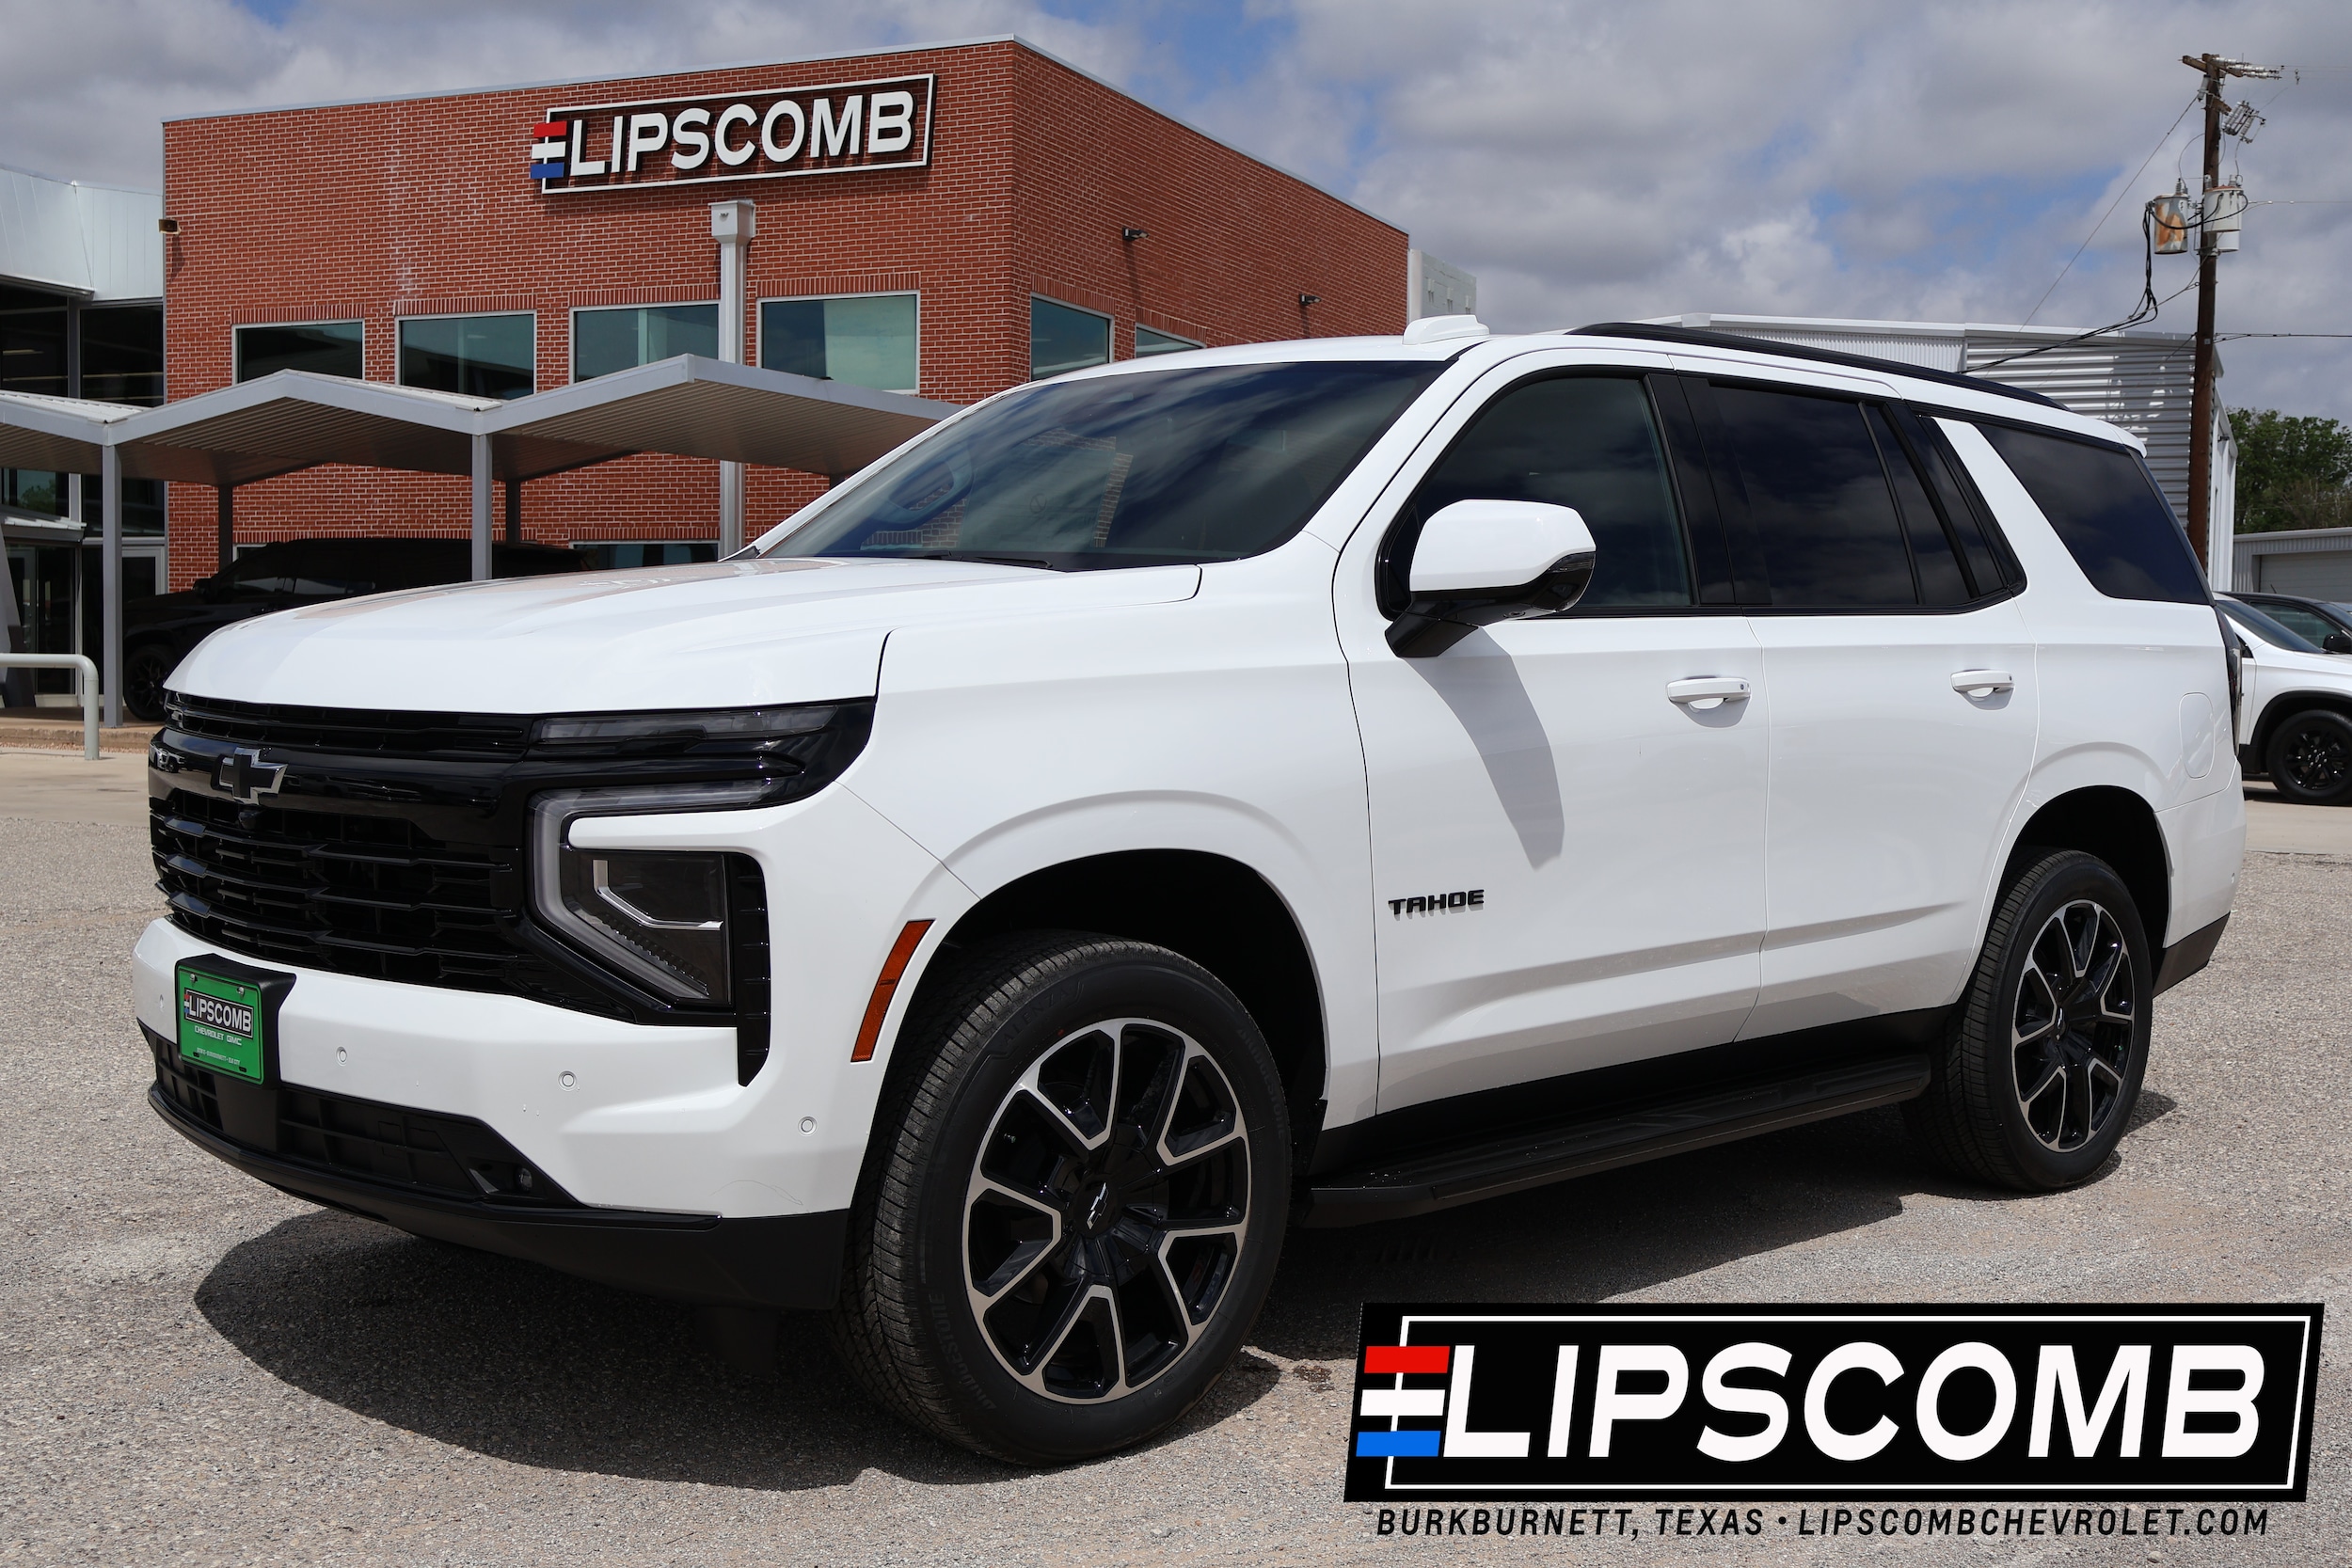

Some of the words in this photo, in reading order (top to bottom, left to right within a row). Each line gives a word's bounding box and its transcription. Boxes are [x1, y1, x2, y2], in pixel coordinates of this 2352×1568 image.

[570, 90, 914, 177] LIPSCOMB
[1388, 889, 1485, 915] TAHOE
[189, 995, 251, 1032] LIPSCOMB
[194, 1025, 224, 1041] CHEVROLET
[227, 1035, 242, 1046] GMC
